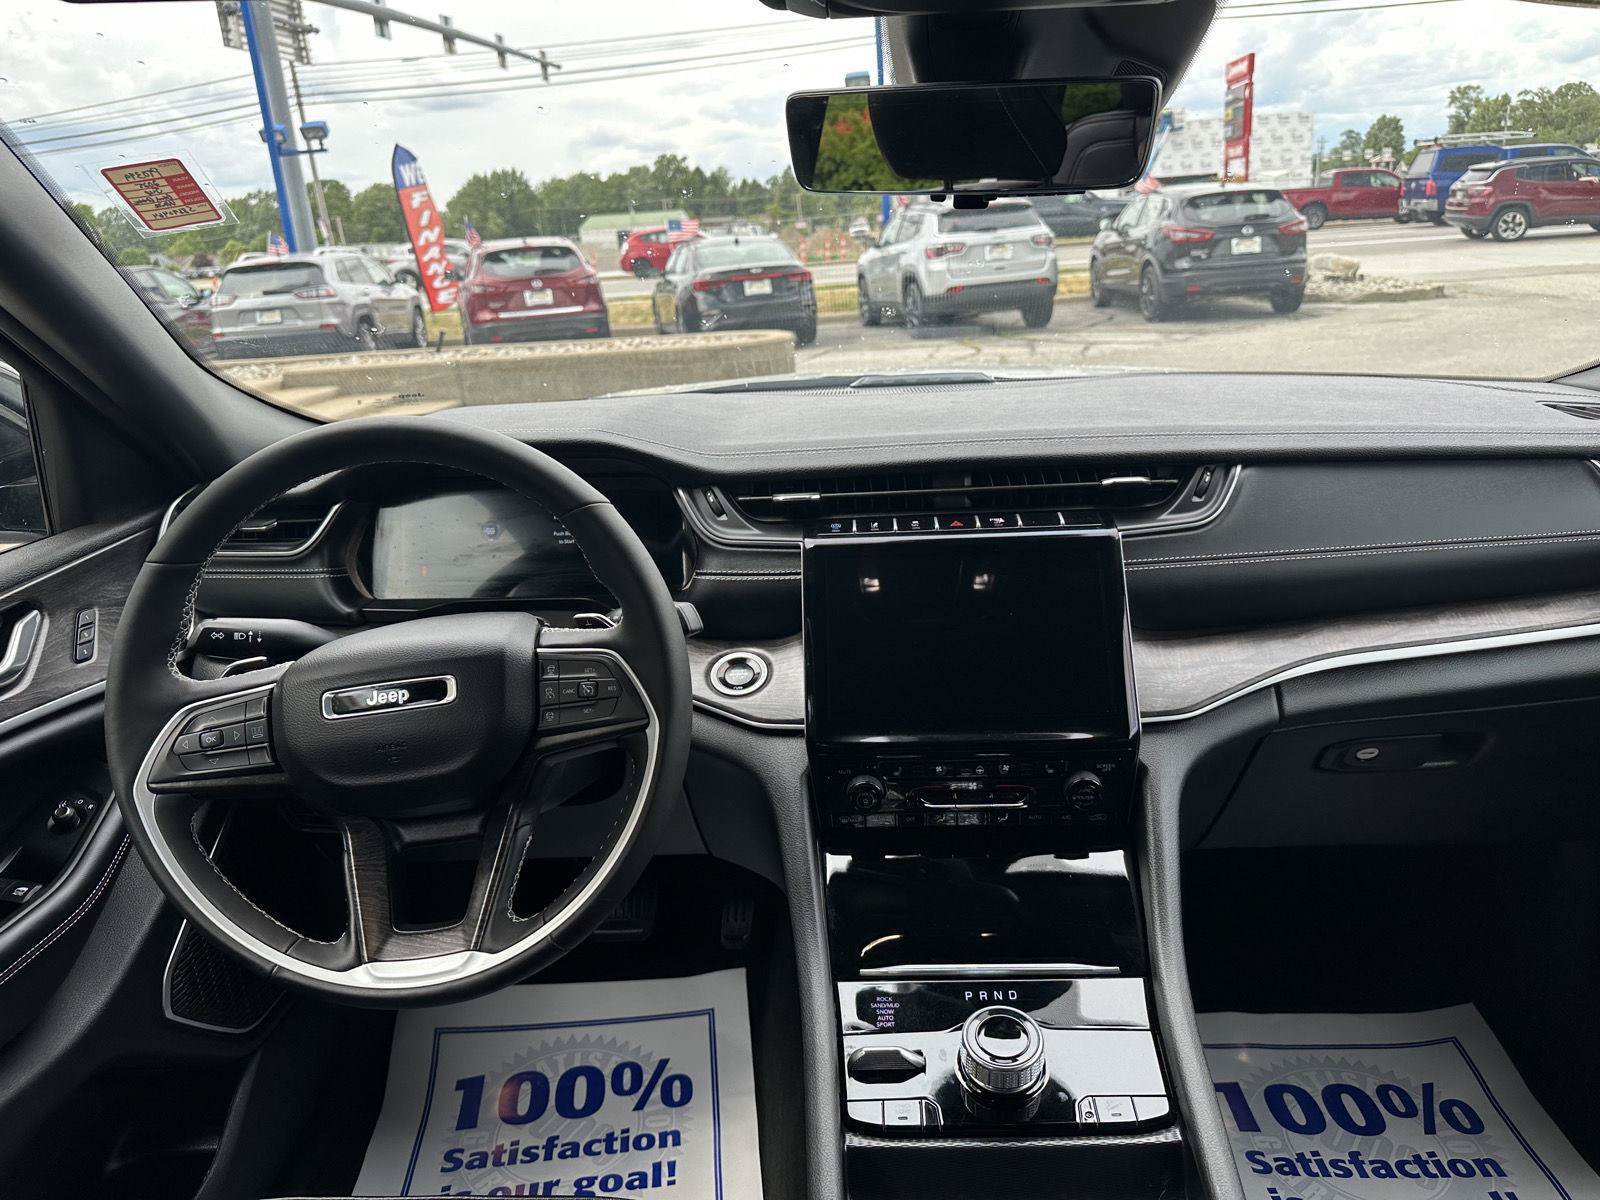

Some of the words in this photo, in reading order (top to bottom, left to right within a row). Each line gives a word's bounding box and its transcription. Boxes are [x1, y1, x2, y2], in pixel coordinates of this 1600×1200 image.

[409, 191, 457, 304] FINANCE
[366, 689, 410, 706] Jeep
[205, 736, 217, 744] OK
[455, 1057, 694, 1131] 100%
[1215, 1081, 1486, 1137] 100%
[440, 1127, 682, 1173] Satisfaction
[1245, 1149, 1509, 1181] Satisfaction
[572, 1160, 677, 1197] goal!
